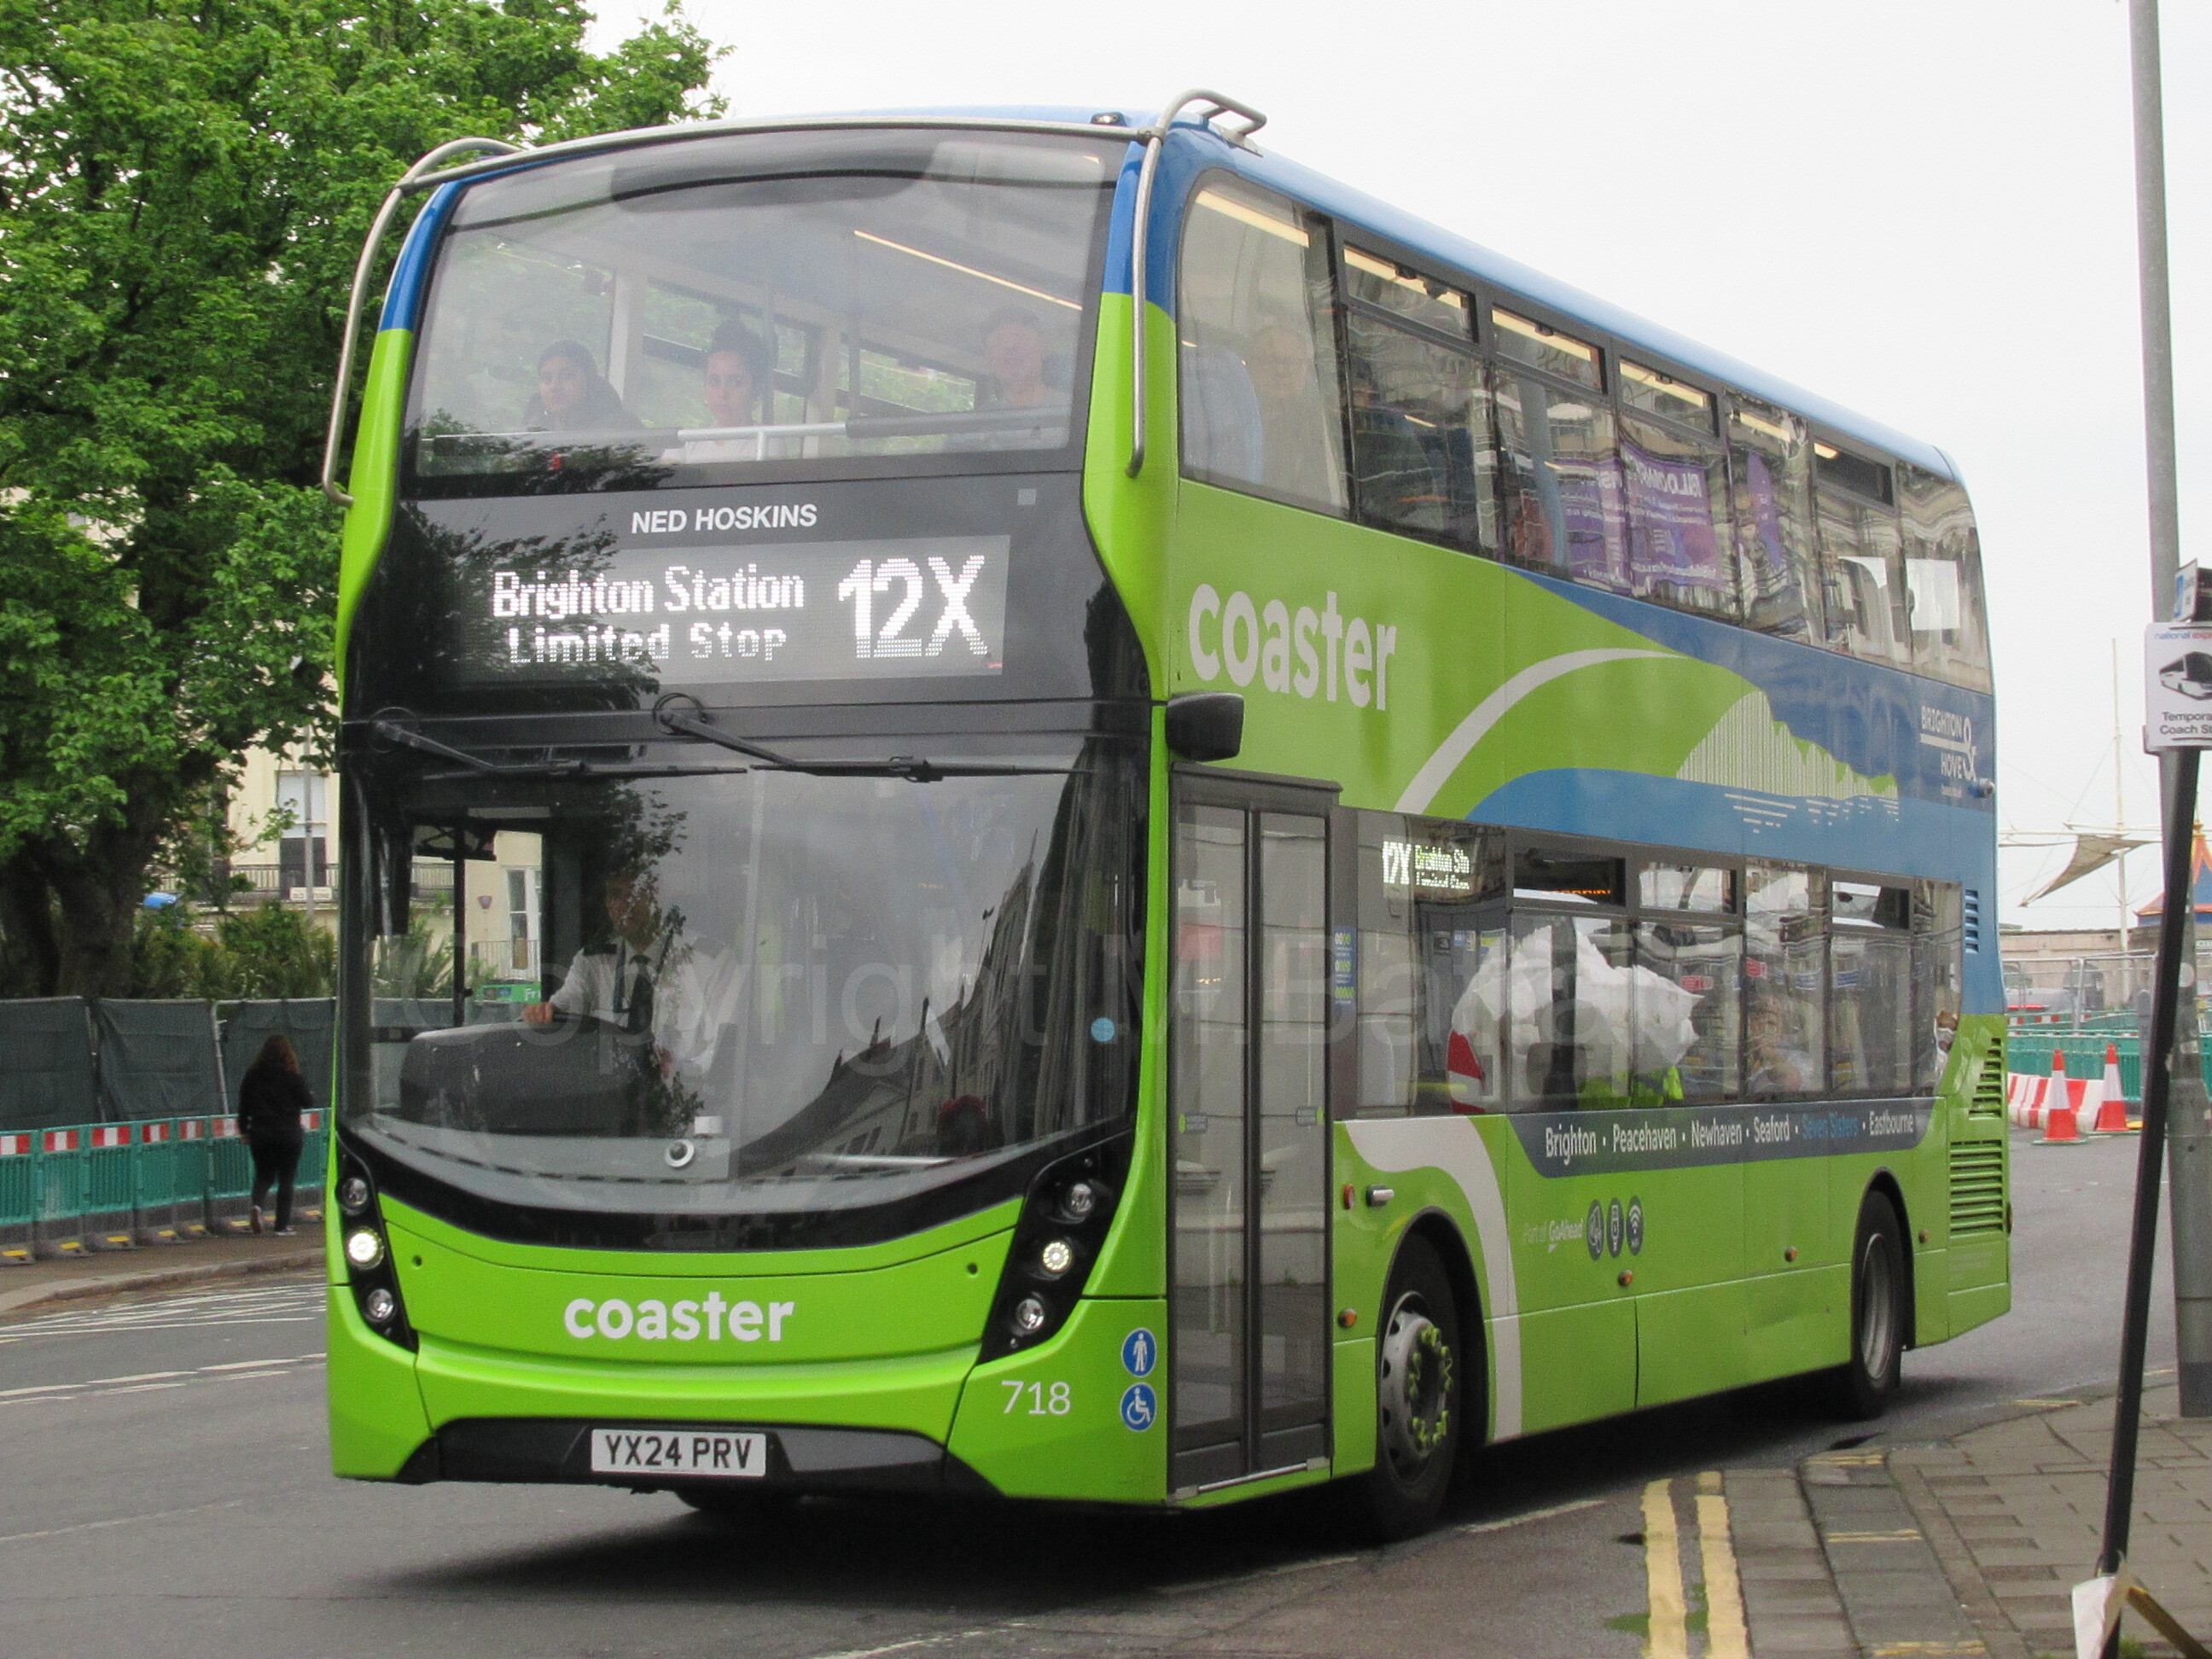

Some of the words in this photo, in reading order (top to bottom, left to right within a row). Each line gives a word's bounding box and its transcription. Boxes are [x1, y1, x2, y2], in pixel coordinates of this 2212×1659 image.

[631, 509, 686, 535] NED
[695, 504, 818, 532] HOSKINS
[492, 568, 655, 620] Brighton
[663, 563, 805, 612] Station
[837, 555, 989, 660] 12X
[508, 623, 670, 664] Limited
[689, 621, 787, 661] Stop
[1188, 583, 1397, 711] coaster
[1921, 705, 1963, 738] BRIGHTON
[2159, 724, 2198, 735] Coach
[1941, 752, 1963, 779] HOVE
[1545, 1123, 1597, 1166] Brighton
[1613, 1121, 1677, 1153] Peacehaven
[1691, 1118, 1743, 1148] Newhaven
[1753, 1113, 1790, 1143] Seaford
[1869, 1109, 1914, 1136] Eastbourne
[562, 1291, 795, 1342] coaster
[1000, 1379, 1073, 1416] 718
[605, 1435, 683, 1467] YX24
[692, 1437, 753, 1469] PRV
